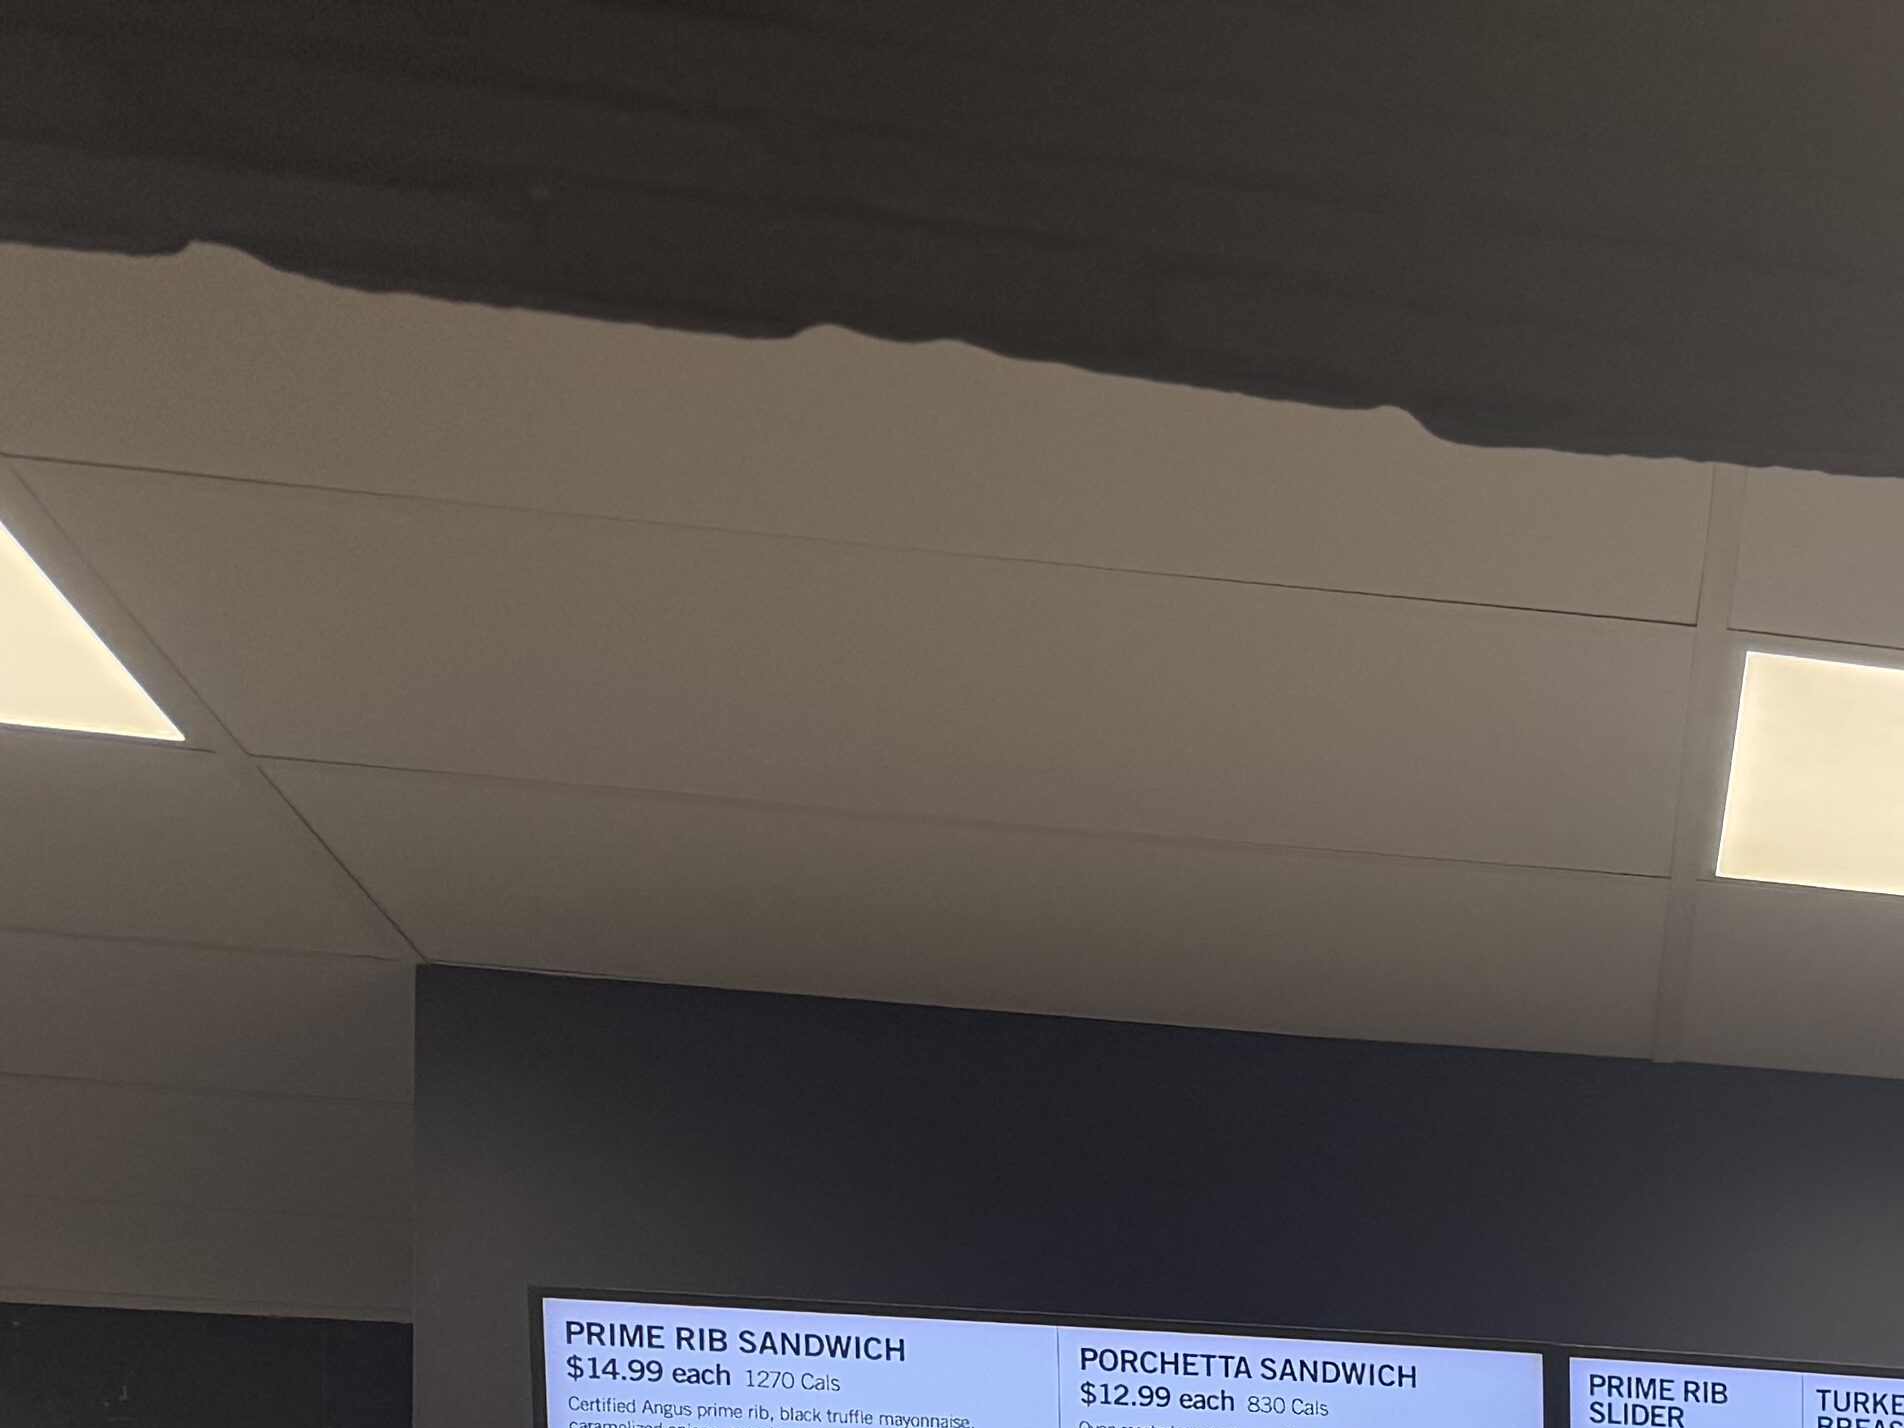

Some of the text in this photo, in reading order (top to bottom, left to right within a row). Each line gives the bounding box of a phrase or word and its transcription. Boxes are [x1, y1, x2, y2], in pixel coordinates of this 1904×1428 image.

[566, 1321, 904, 1361] PRIME RIB SANDWICH
[567, 1355, 840, 1391] $14.99 each 1270 Cals
[1081, 1348, 1416, 1388] PORCHETTA SANDWICH
[1081, 1381, 1328, 1416] $12.99 each 830 Cals
[1590, 1374, 1727, 1404] PRIME RIB
[569, 1396, 635, 1413] Certified
[642, 1400, 692, 1418] Angus
[698, 1403, 742, 1419] prime
[749, 1405, 773, 1421] rib,
[781, 1407, 821, 1422] black
[827, 1410, 873, 1425] truffle
[1590, 1401, 1684, 1428] SLIDER
